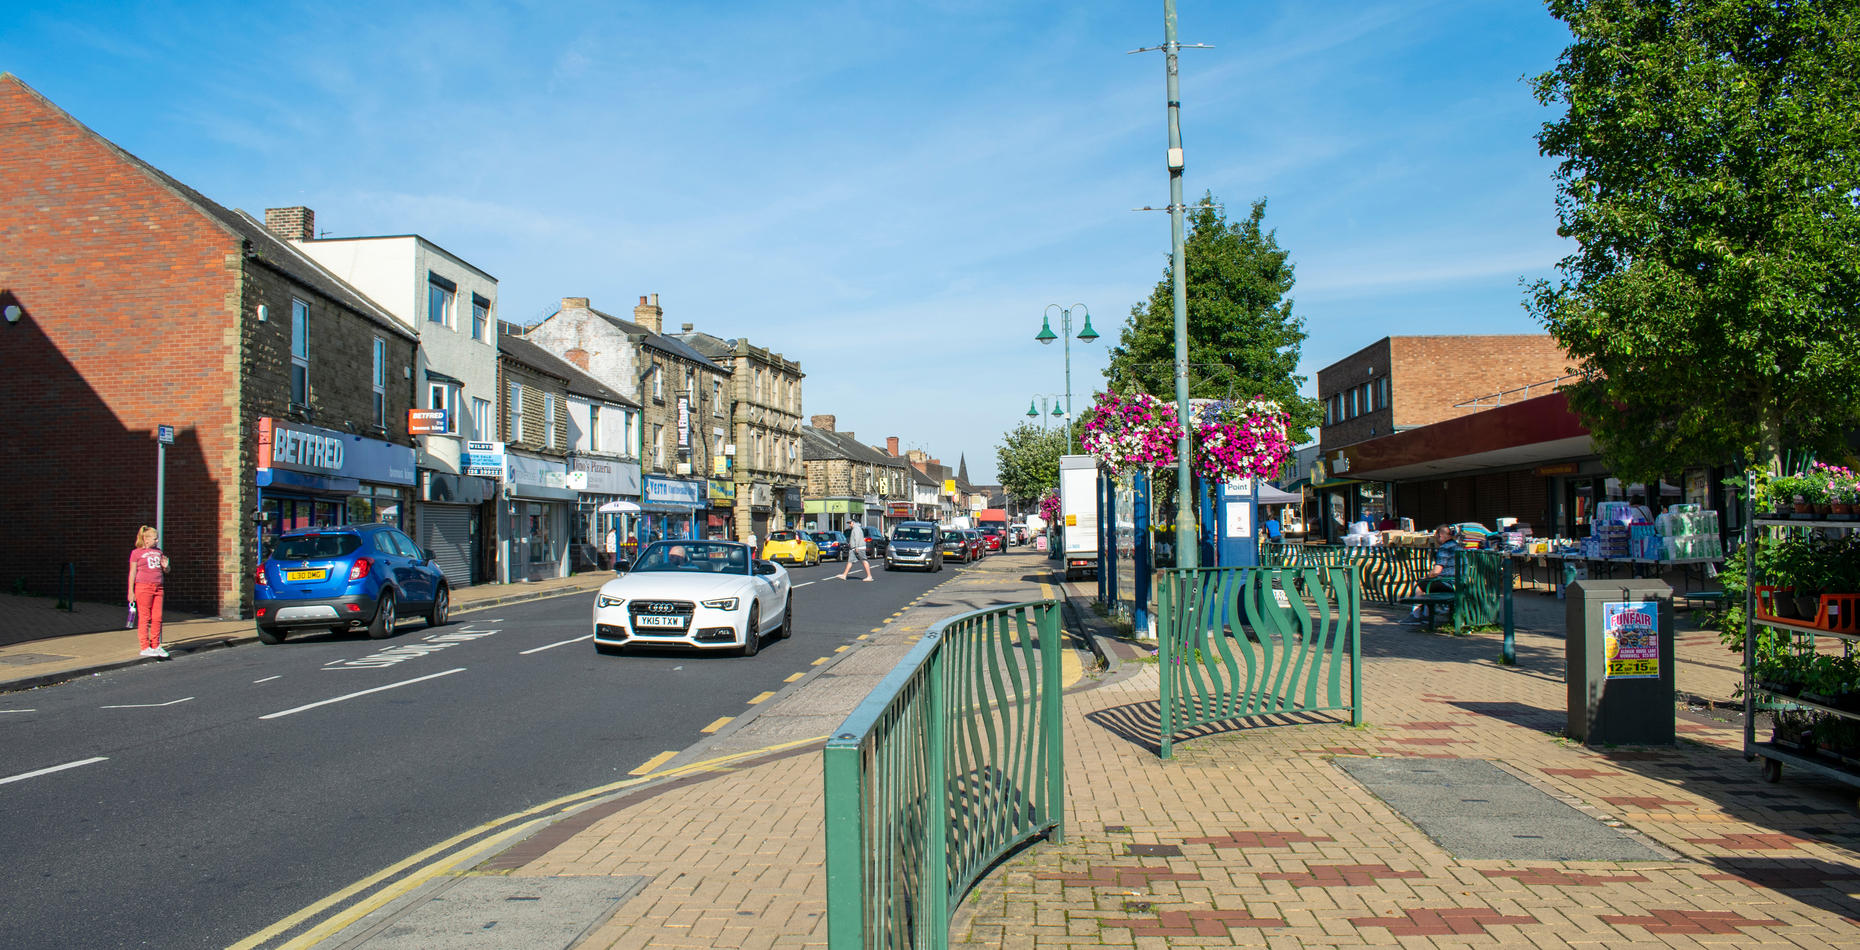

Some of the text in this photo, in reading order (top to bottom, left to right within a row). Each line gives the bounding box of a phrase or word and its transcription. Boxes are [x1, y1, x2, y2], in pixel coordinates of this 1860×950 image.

[274, 427, 344, 470] BETFRED
[389, 466, 414, 483] bonus king
[591, 461, 611, 474] Pizzeria
[642, 616, 678, 625] YK15 TXW
[1611, 612, 1651, 626] FUNFAIR
